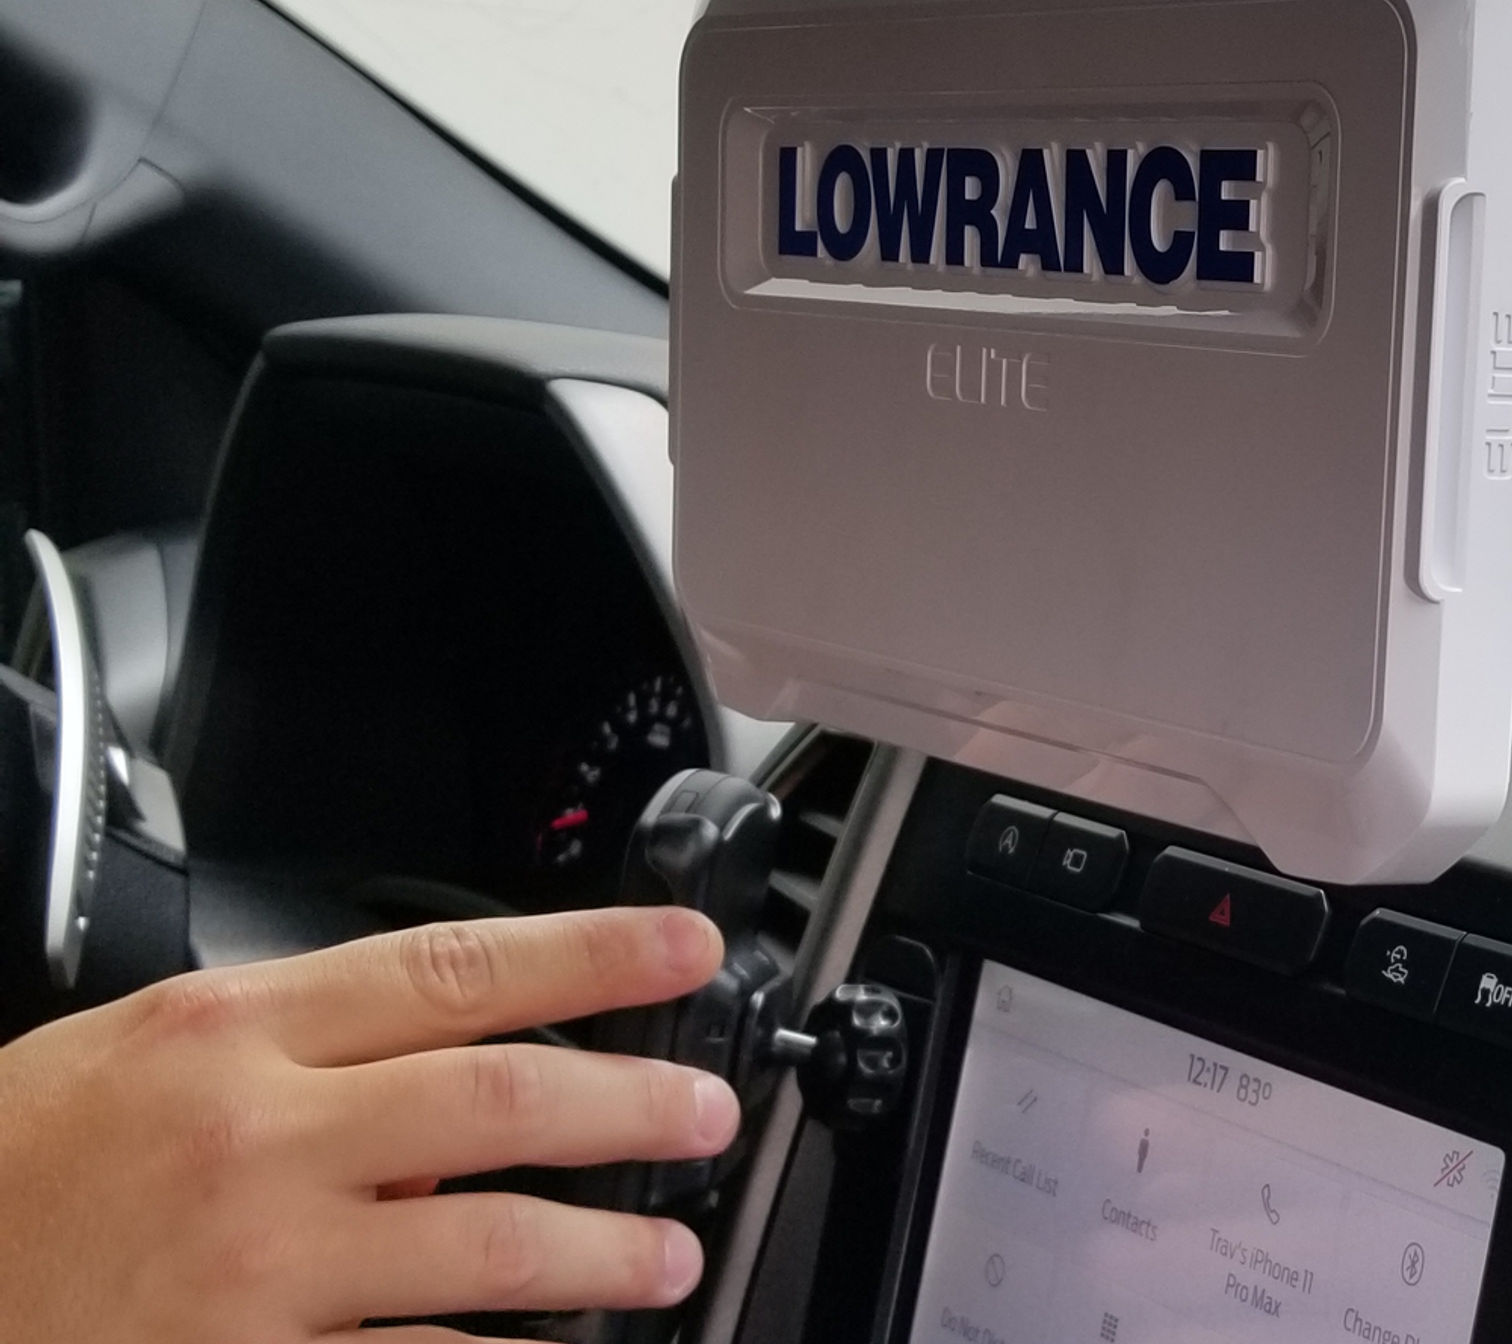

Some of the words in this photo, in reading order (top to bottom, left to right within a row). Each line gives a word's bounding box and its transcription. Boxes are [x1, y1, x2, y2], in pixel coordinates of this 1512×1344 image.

[777, 144, 1260, 286] LOWRANCE
[926, 342, 1051, 412] ELITE
[1187, 1053, 1229, 1094] 12:17
[1012, 1158, 1036, 1187] Call
[1036, 1169, 1058, 1197] List
[1101, 1198, 1158, 1243] Contacts
[1209, 1228, 1248, 1265] Trav's
[1249, 1247, 1299, 1288] iPhone
[1302, 1269, 1314, 1295] 11
[1224, 1272, 1249, 1303] Pro
[1250, 1285, 1283, 1318] Max
